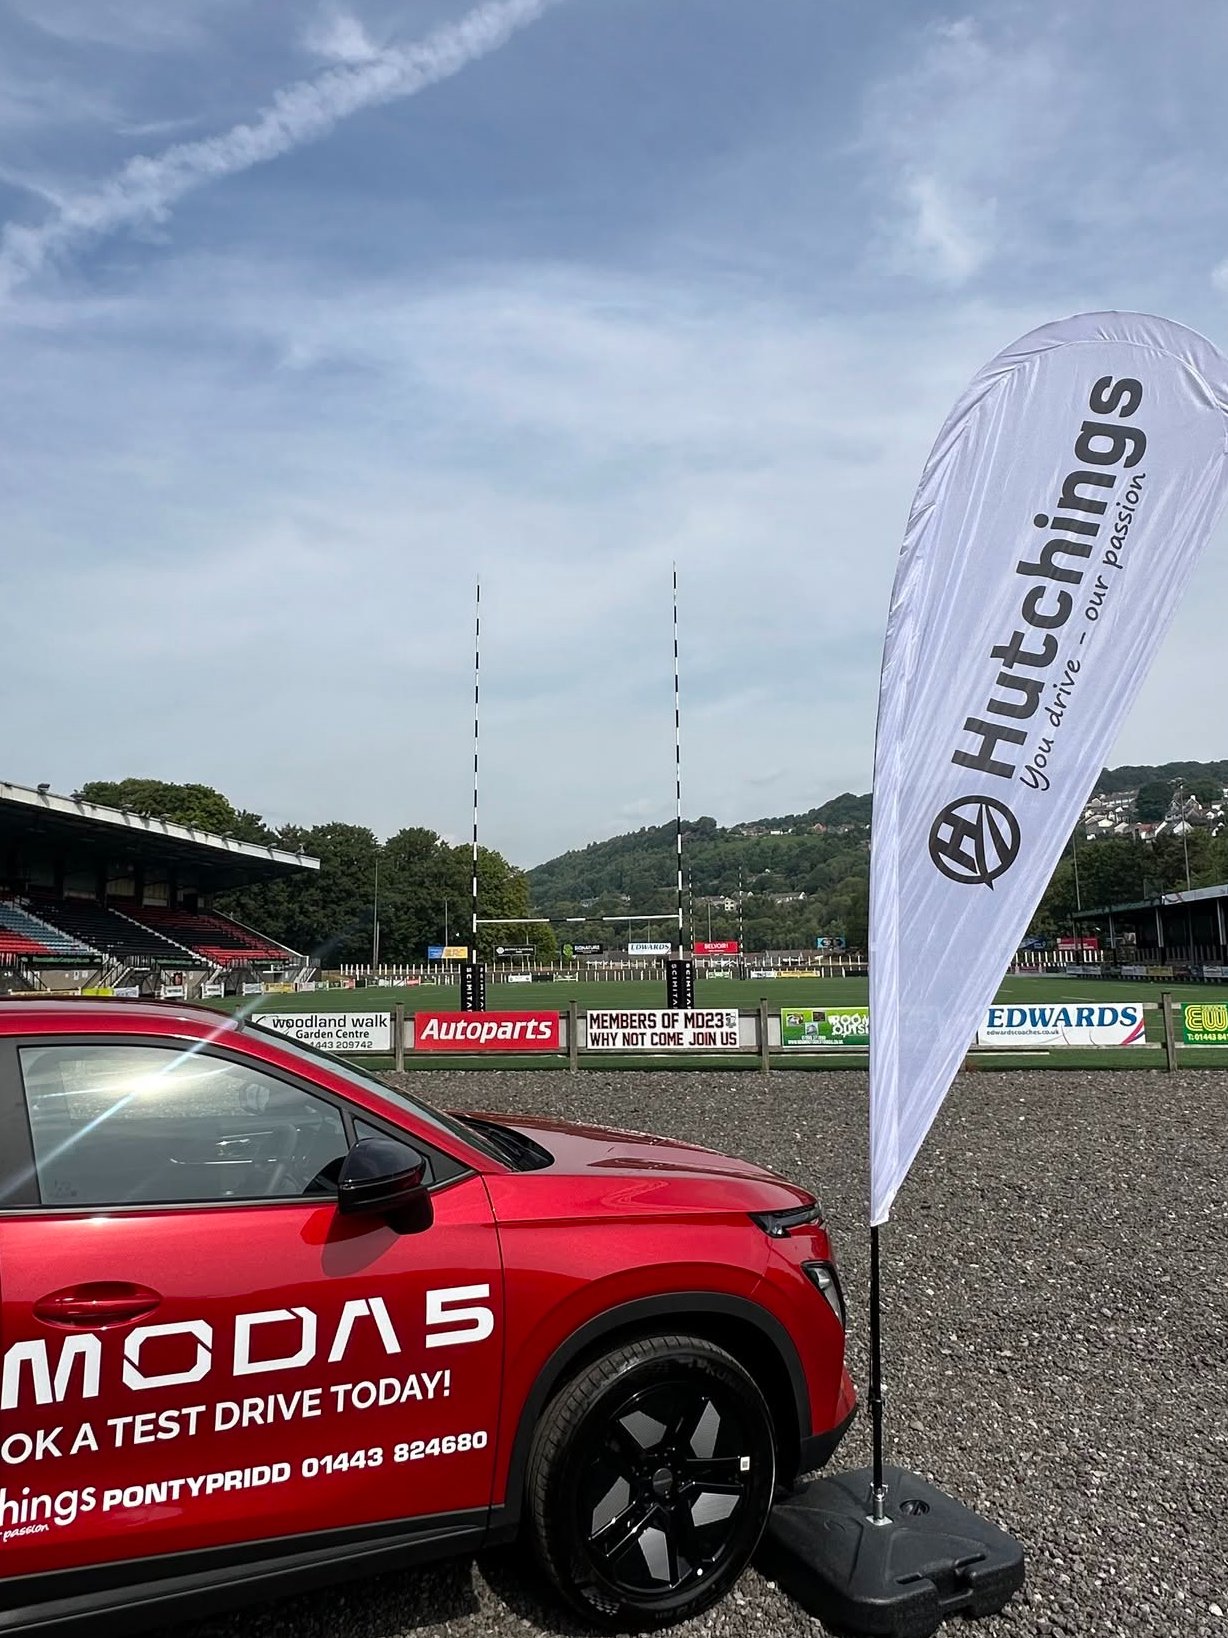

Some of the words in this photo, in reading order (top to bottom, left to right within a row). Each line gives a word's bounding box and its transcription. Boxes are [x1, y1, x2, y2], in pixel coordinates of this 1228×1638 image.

[951, 375, 1147, 780] Hutchings
[1019, 736, 1055, 791] You
[1049, 659, 1082, 726] drive
[1085, 573, 1106, 622] our
[1102, 472, 1147, 569] passion
[630, 942, 669, 951] EDWARDS
[272, 1015, 346, 1028] woodland
[351, 1015, 388, 1028] walk
[589, 1013, 657, 1029] MEMBERS
[661, 1013, 679, 1029] OF
[684, 1012, 724, 1029] MD23
[986, 1006, 1138, 1028] EDWARDS
[295, 1030, 333, 1039] Garden
[335, 1030, 370, 1039] Centre
[420, 1018, 553, 1044] Autoparts
[590, 1032, 618, 1046] WHY
[622, 1032, 646, 1046] NOT
[650, 1032, 684, 1046] COME
[688, 1032, 717, 1046] JOIN
[720, 1032, 737, 1046] US
[309, 1041, 334, 1049] 1443
[336, 1041, 373, 1049] 209742
[0, 1297, 402, 1411] MODA
[425, 1283, 495, 1348] 5
[1, 1425, 66, 1465] OK
[70, 1422, 99, 1454] A
[107, 1405, 206, 1447] TEST
[214, 1388, 322, 1432] DRIVE
[330, 1369, 452, 1412] TODAY!
[0, 1486, 97, 1526] hings
[102, 1462, 291, 1512] PONTYPRIDD
[301, 1447, 384, 1478] 01443
[393, 1430, 488, 1462] 824680
[3, 1524, 50, 1543] passion
